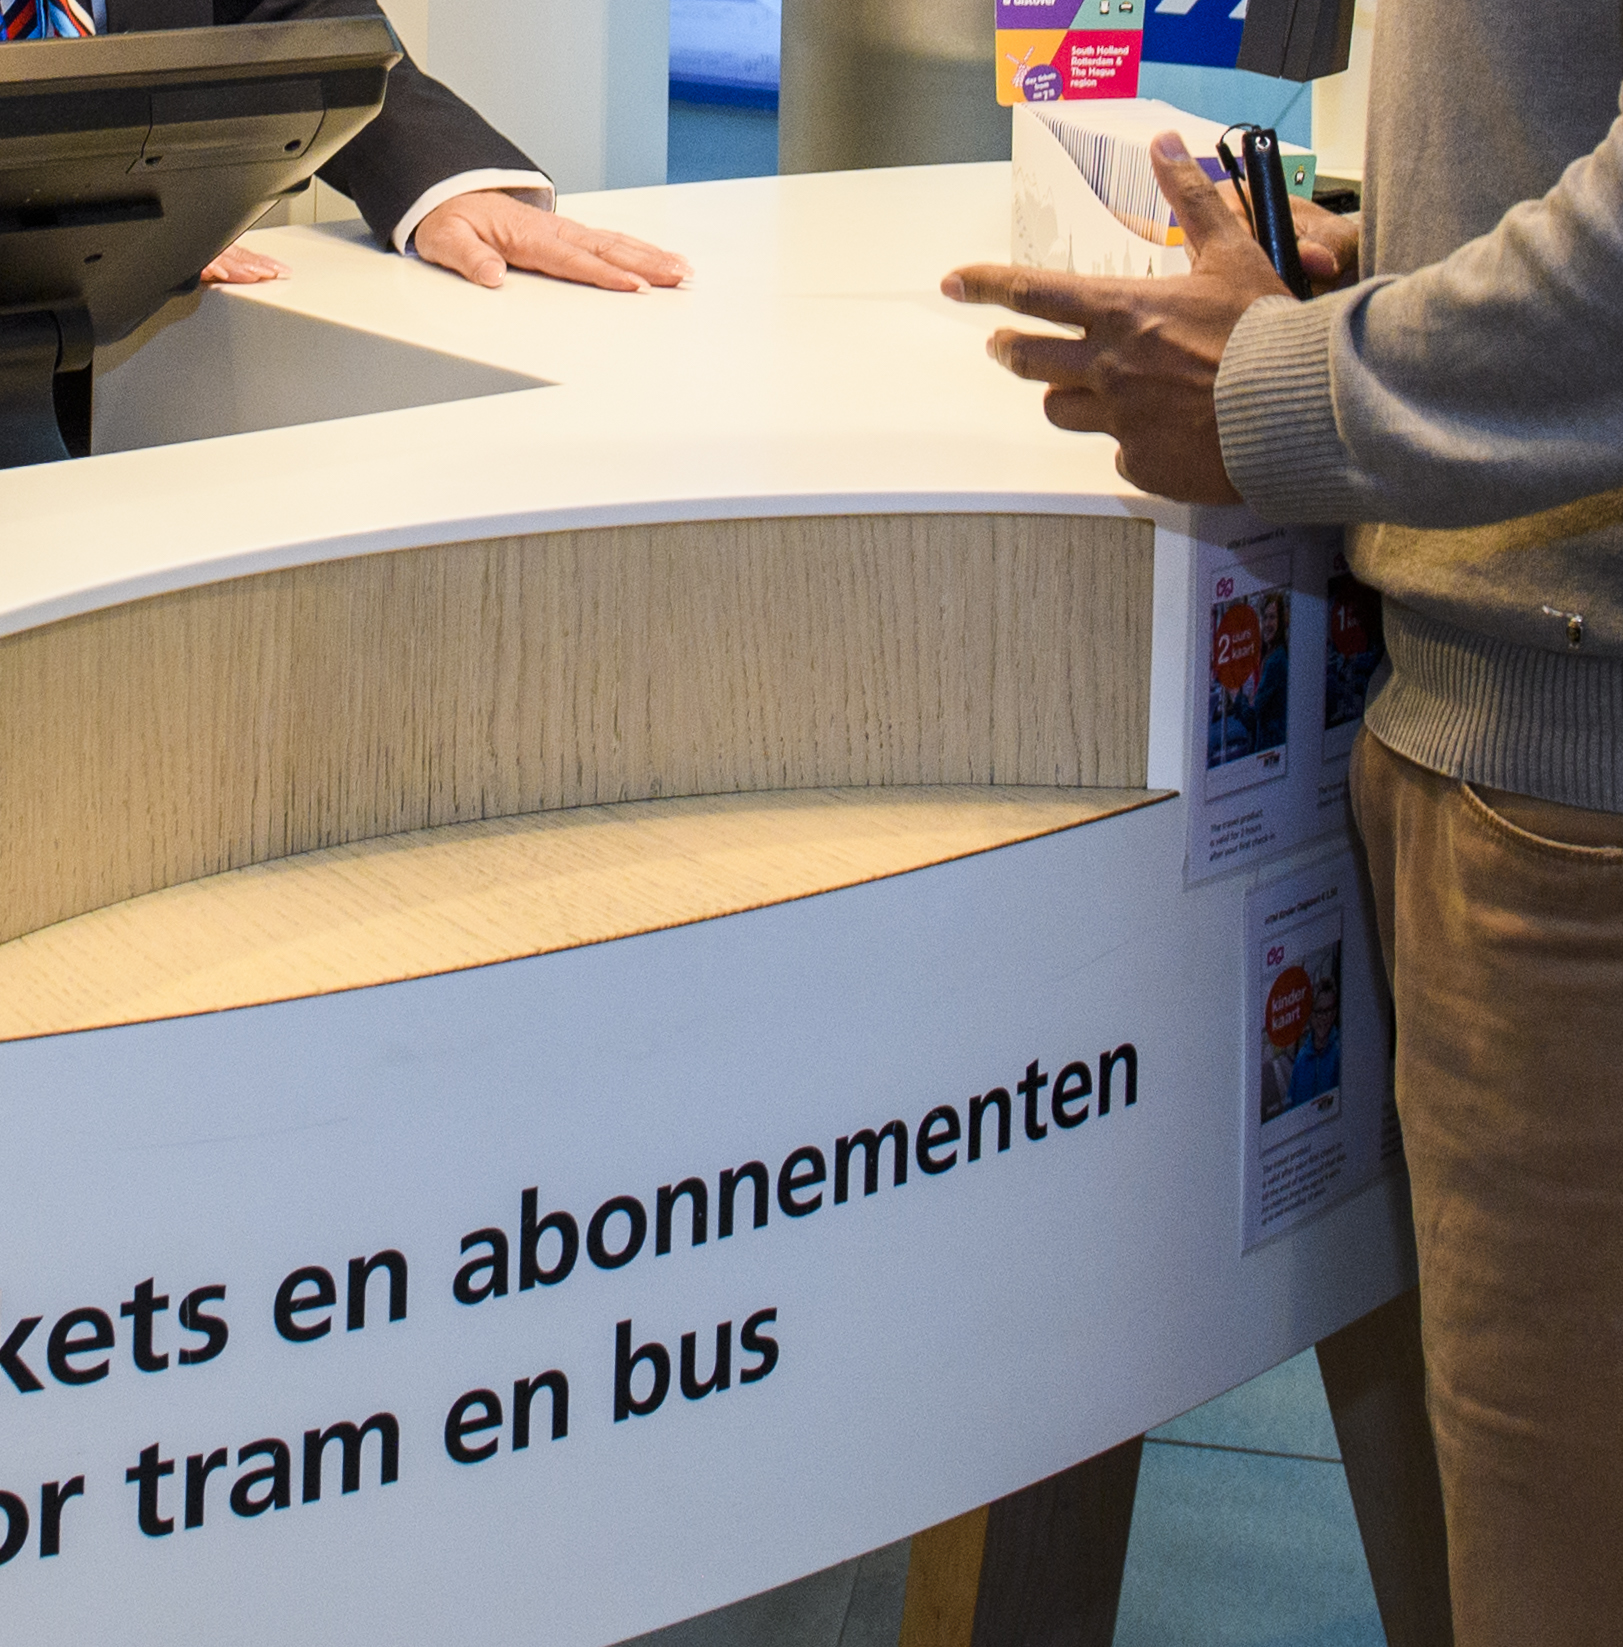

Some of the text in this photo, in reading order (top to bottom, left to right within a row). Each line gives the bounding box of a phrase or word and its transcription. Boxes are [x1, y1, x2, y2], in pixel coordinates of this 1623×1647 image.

[1070, 45, 1130, 56] South Holland
[1070, 66, 1116, 78] The Hague
[1070, 78, 1097, 89] region
[1217, 632, 1255, 666] 2 kaart
[1271, 986, 1308, 1012] kinder
[1271, 1008, 1302, 1031] kaart
[272, 1247, 409, 1345] en
[452, 1040, 1142, 1306] abonnementen
[126, 1405, 401, 1536] tram
[442, 1367, 570, 1465] en
[612, 1303, 782, 1423] bus
